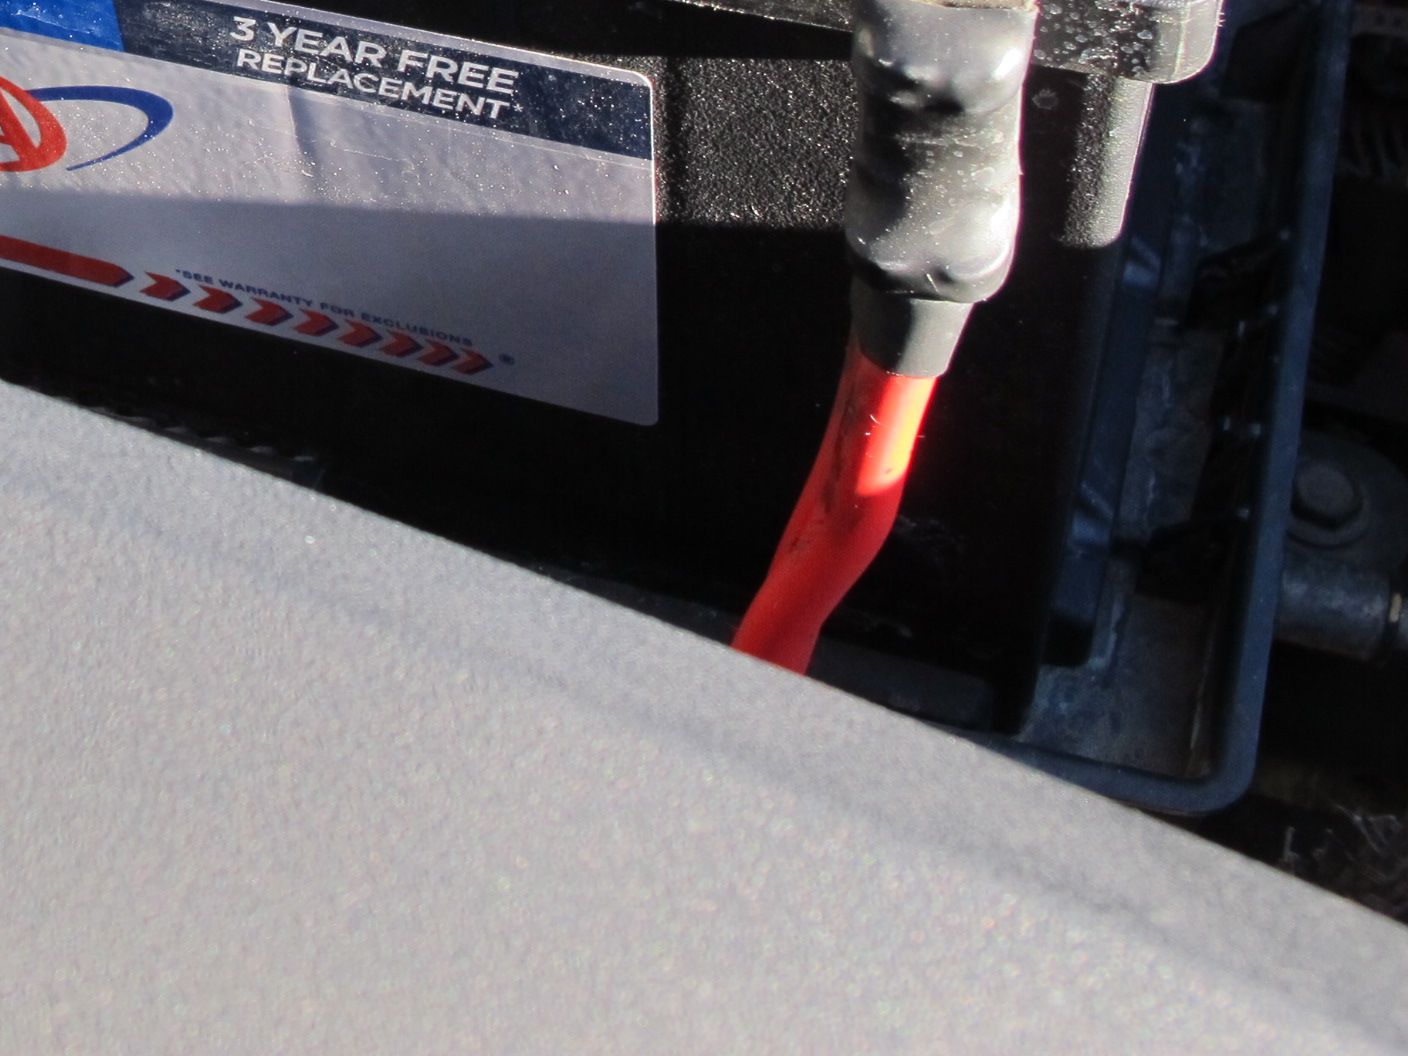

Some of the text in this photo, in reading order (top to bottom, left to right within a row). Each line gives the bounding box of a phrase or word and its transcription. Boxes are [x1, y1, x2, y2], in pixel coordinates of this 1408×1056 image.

[229, 15, 520, 95] 3 YEAR FREE
[218, 278, 315, 311] WARRANTY
[320, 301, 356, 319] FOR
[359, 310, 474, 347] EXCLUSIONS
